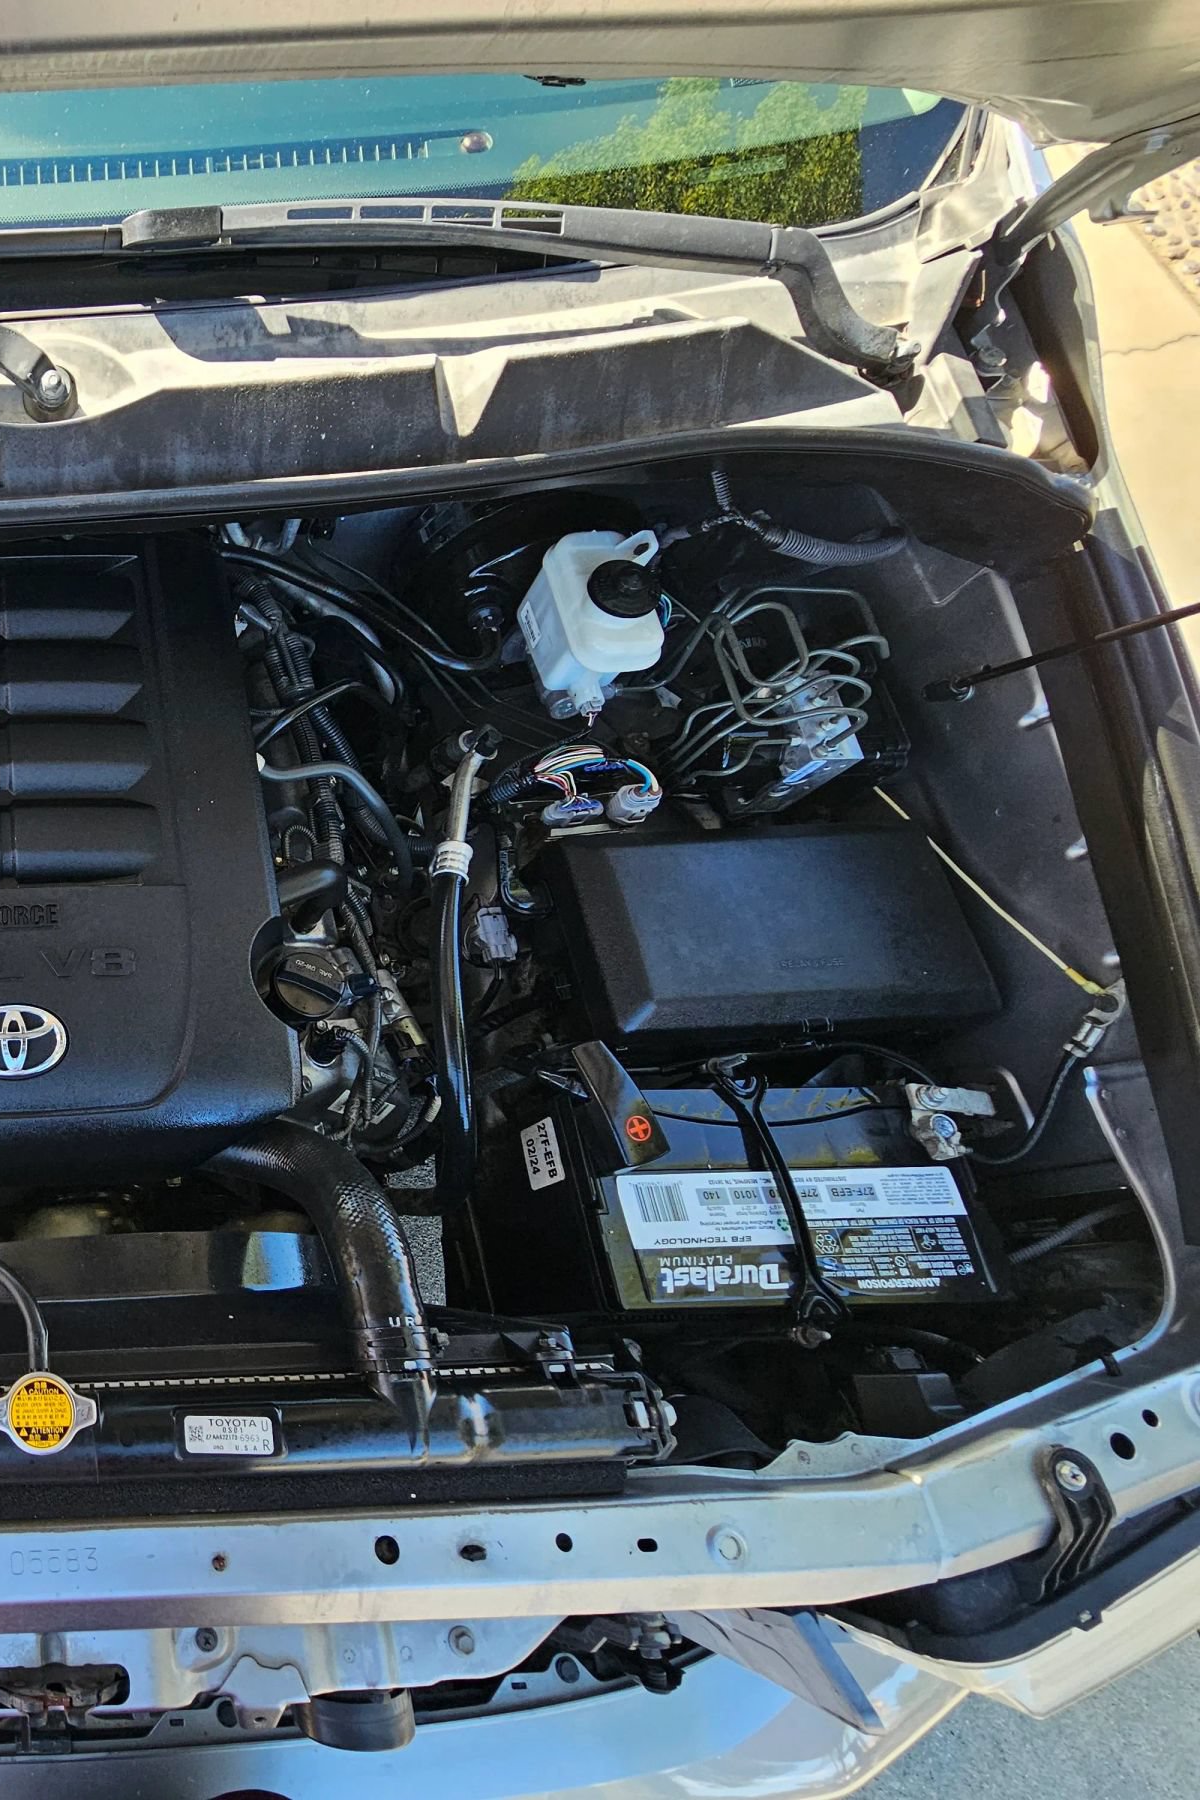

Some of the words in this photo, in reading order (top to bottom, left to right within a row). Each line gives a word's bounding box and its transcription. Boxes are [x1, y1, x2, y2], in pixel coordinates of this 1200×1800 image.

[40, 949, 137, 977] V8
[536, 1122, 558, 1178] 27F-EFB
[702, 1190, 720, 1200] 140
[733, 1190, 757, 1200] 1010
[800, 1188, 819, 1198] 27F
[830, 1186, 875, 1197] 27F-EFB
[654, 1236, 728, 1245] TECHNOLOGY
[731, 1235, 752, 1243] EFB
[660, 1255, 733, 1267] PLATINUM
[660, 1263, 793, 1294] Duralast
[388, 1316, 401, 1328] U
[404, 1316, 416, 1328] R
[31, 1426, 64, 1434] ATTENTION
[208, 1418, 257, 1428] TOYOTA
[261, 1419, 269, 1432] U
[262, 1439, 271, 1452] R
